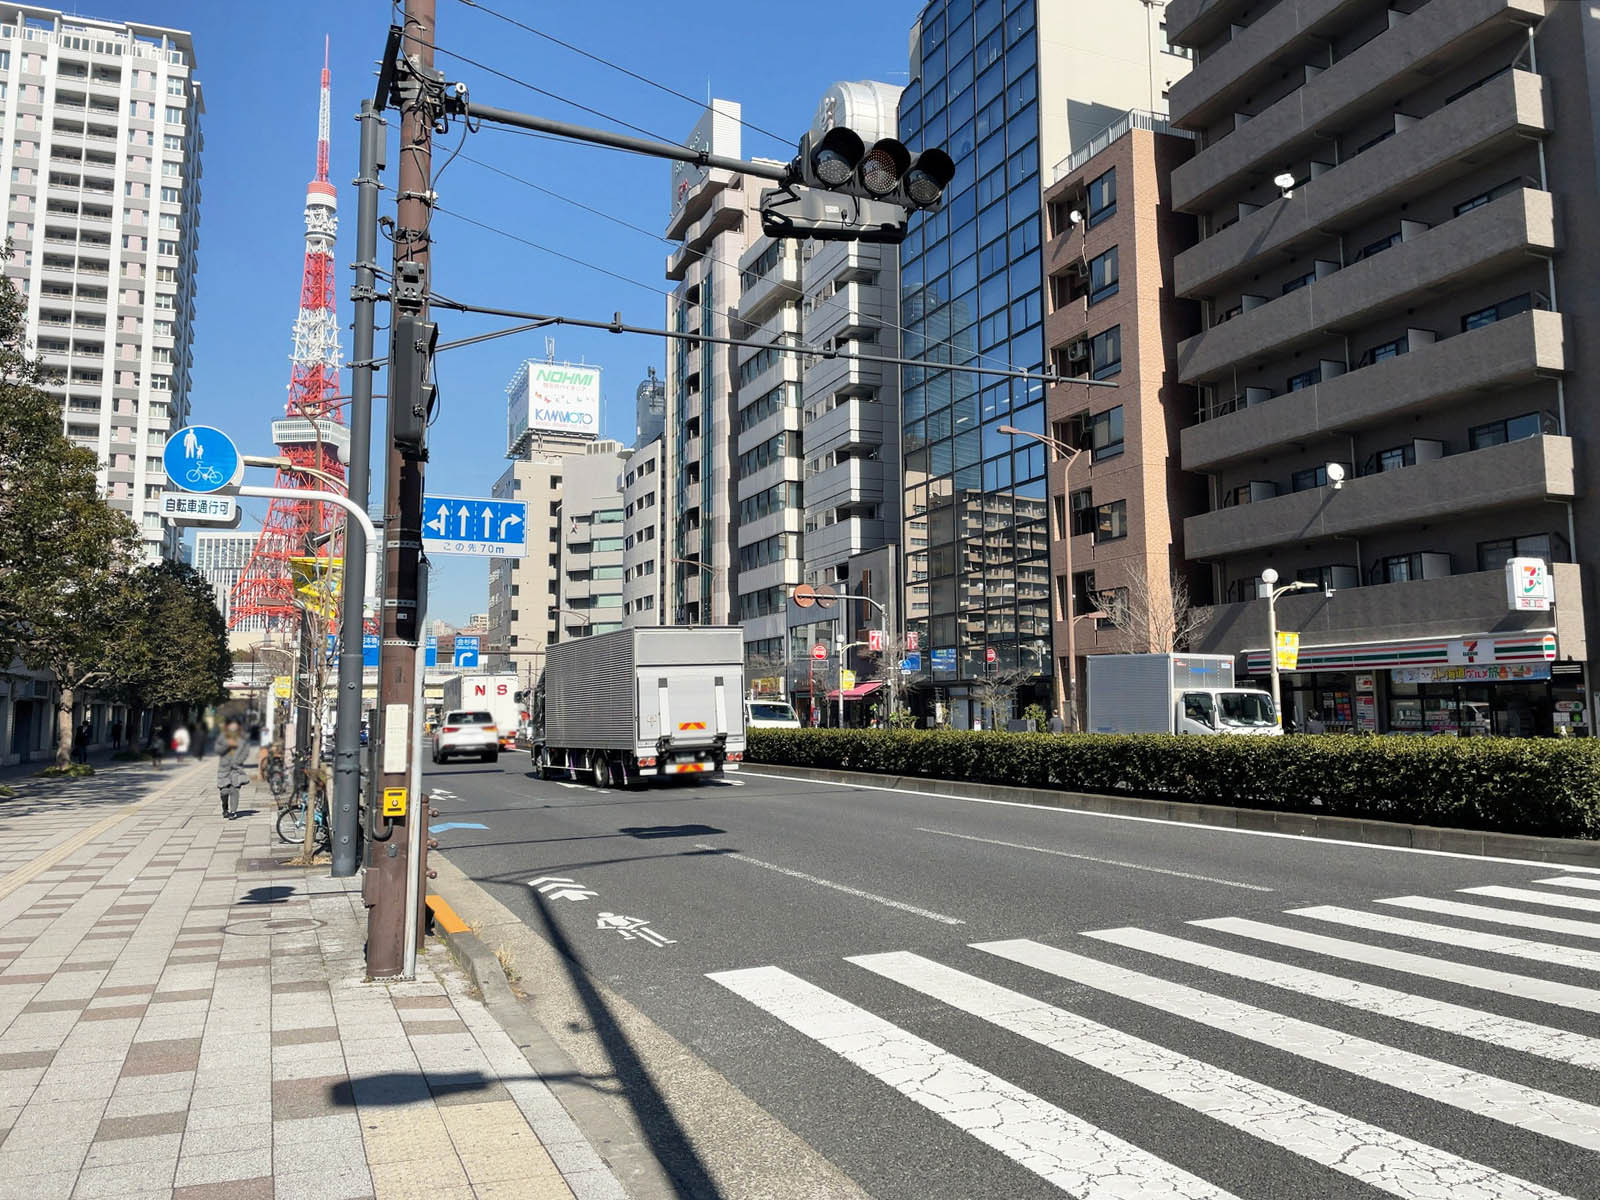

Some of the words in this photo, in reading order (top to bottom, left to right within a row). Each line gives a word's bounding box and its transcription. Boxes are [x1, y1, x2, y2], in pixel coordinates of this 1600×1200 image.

[535, 369, 594, 386] NOHMI
[165, 498, 230, 515] 自転車通行可
